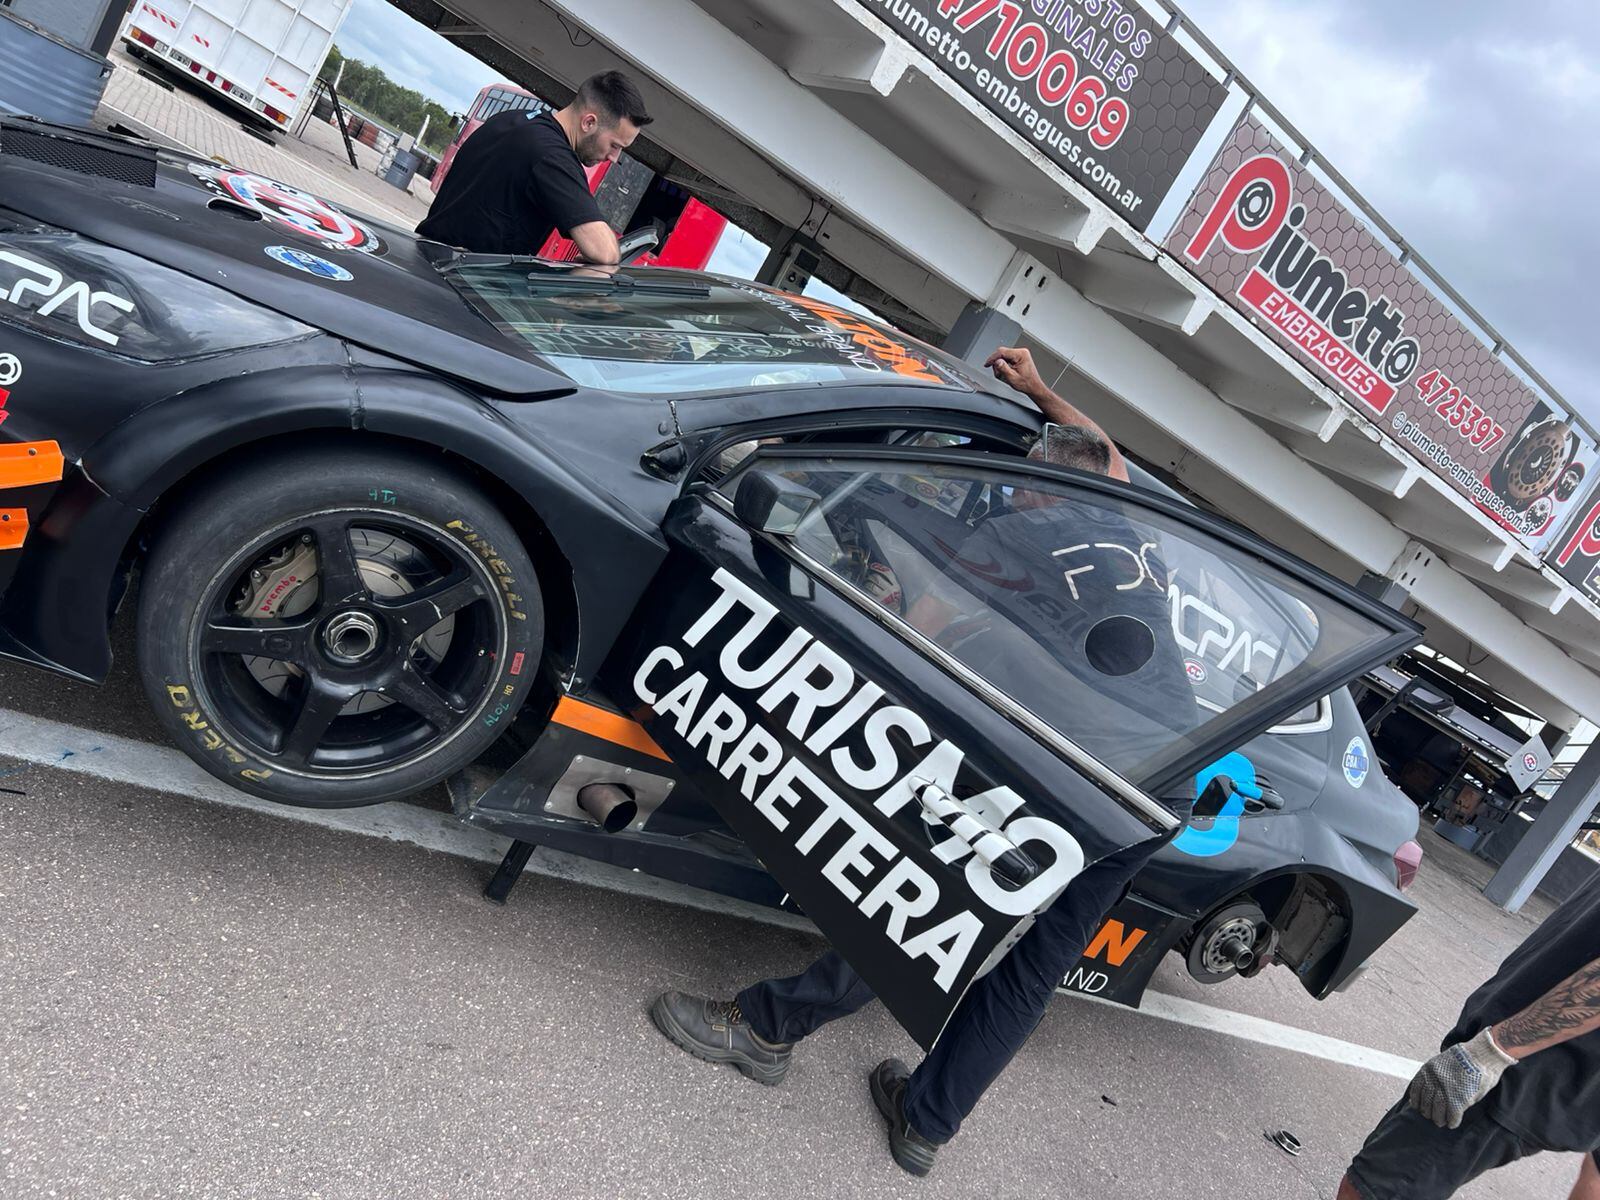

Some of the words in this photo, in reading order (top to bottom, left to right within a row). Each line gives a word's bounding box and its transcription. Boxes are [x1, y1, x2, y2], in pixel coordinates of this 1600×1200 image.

[1077, 0, 1152, 59] STOS
[868, 0, 1143, 212] umetto-embragues.com.ar
[1184, 153, 1420, 385] Piumetto
[805, 324, 882, 373] BRAND
[1260, 291, 1378, 395] EMBRAGUES
[1415, 368, 1505, 453] 4725397
[260, 575, 297, 611] brembo
[682, 567, 1086, 917] TURISMO
[633, 645, 985, 994] CARRETERA
